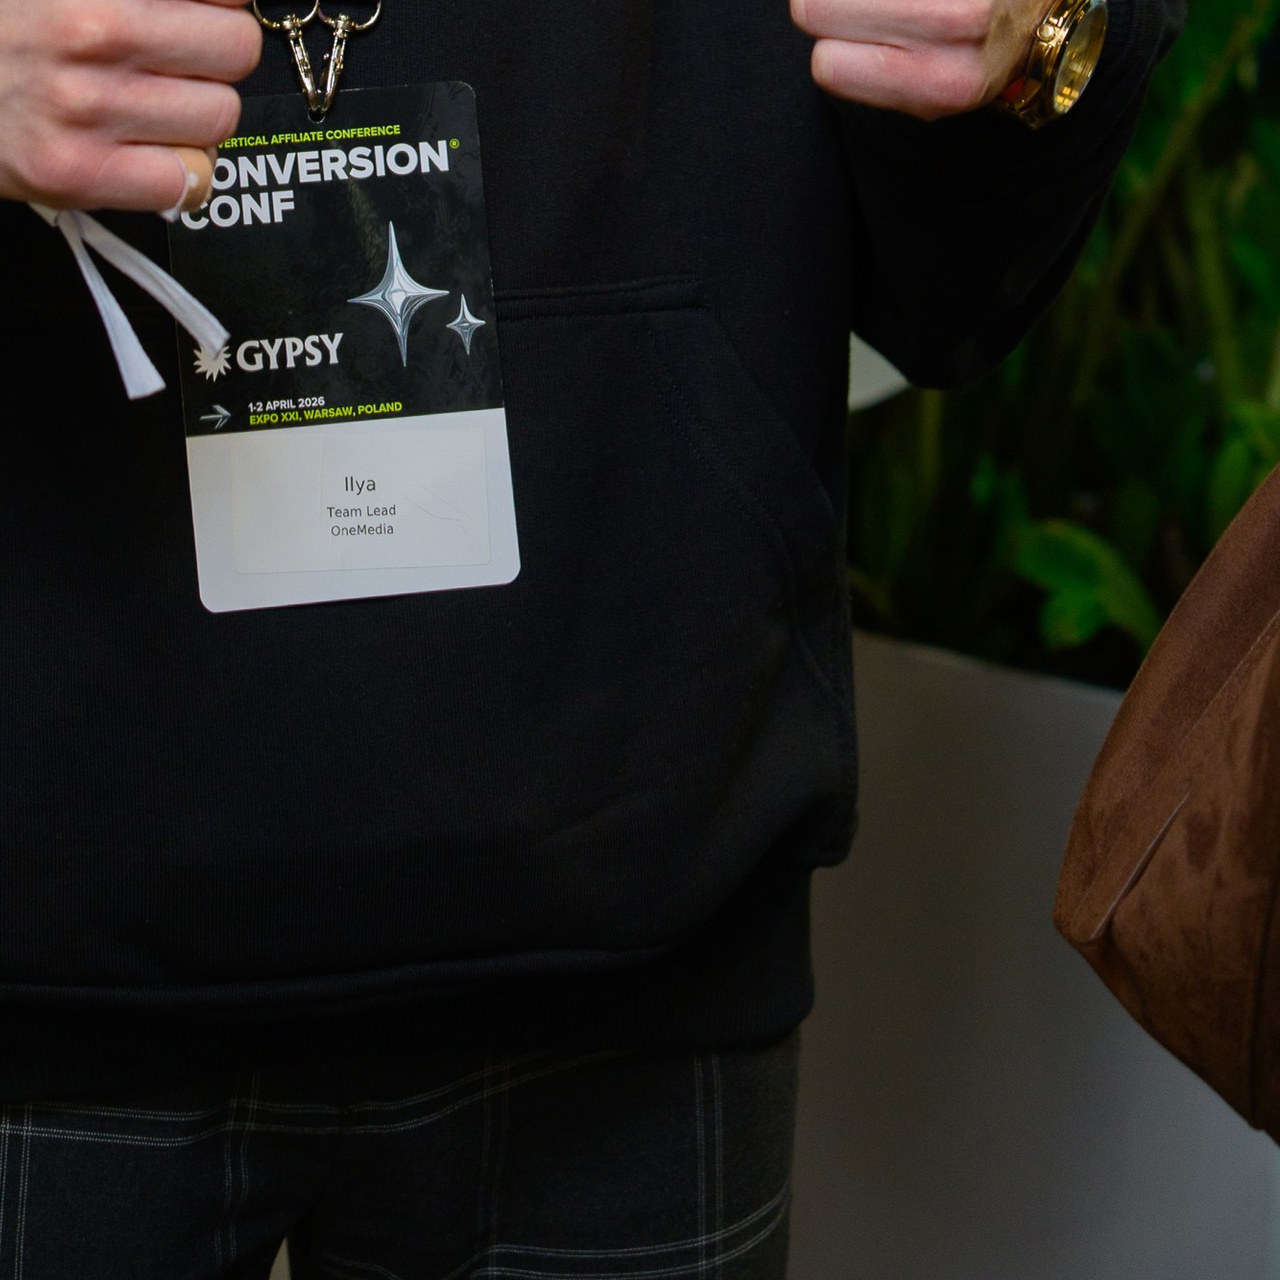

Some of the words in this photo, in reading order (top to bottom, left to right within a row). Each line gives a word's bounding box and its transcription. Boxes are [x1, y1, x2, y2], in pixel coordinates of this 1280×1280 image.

[270, 130, 324, 145] AFFILIATE
[325, 124, 402, 141] CONFERENCE
[210, 139, 450, 190] ONVERSION
[180, 190, 295, 231] CONF
[236, 332, 344, 372] GYPSY
[249, 413, 279, 425] EXPO
[280, 411, 302, 422] XXI,
[303, 405, 356, 420] WARSAW,
[357, 401, 403, 416] POLAND
[265, 399, 297, 411] APRIL
[297, 396, 326, 409] 2026
[344, 475, 377, 496] Ilya
[326, 505, 362, 518] Team
[366, 503, 396, 517] Lead
[330, 523, 394, 537] OneMedia
